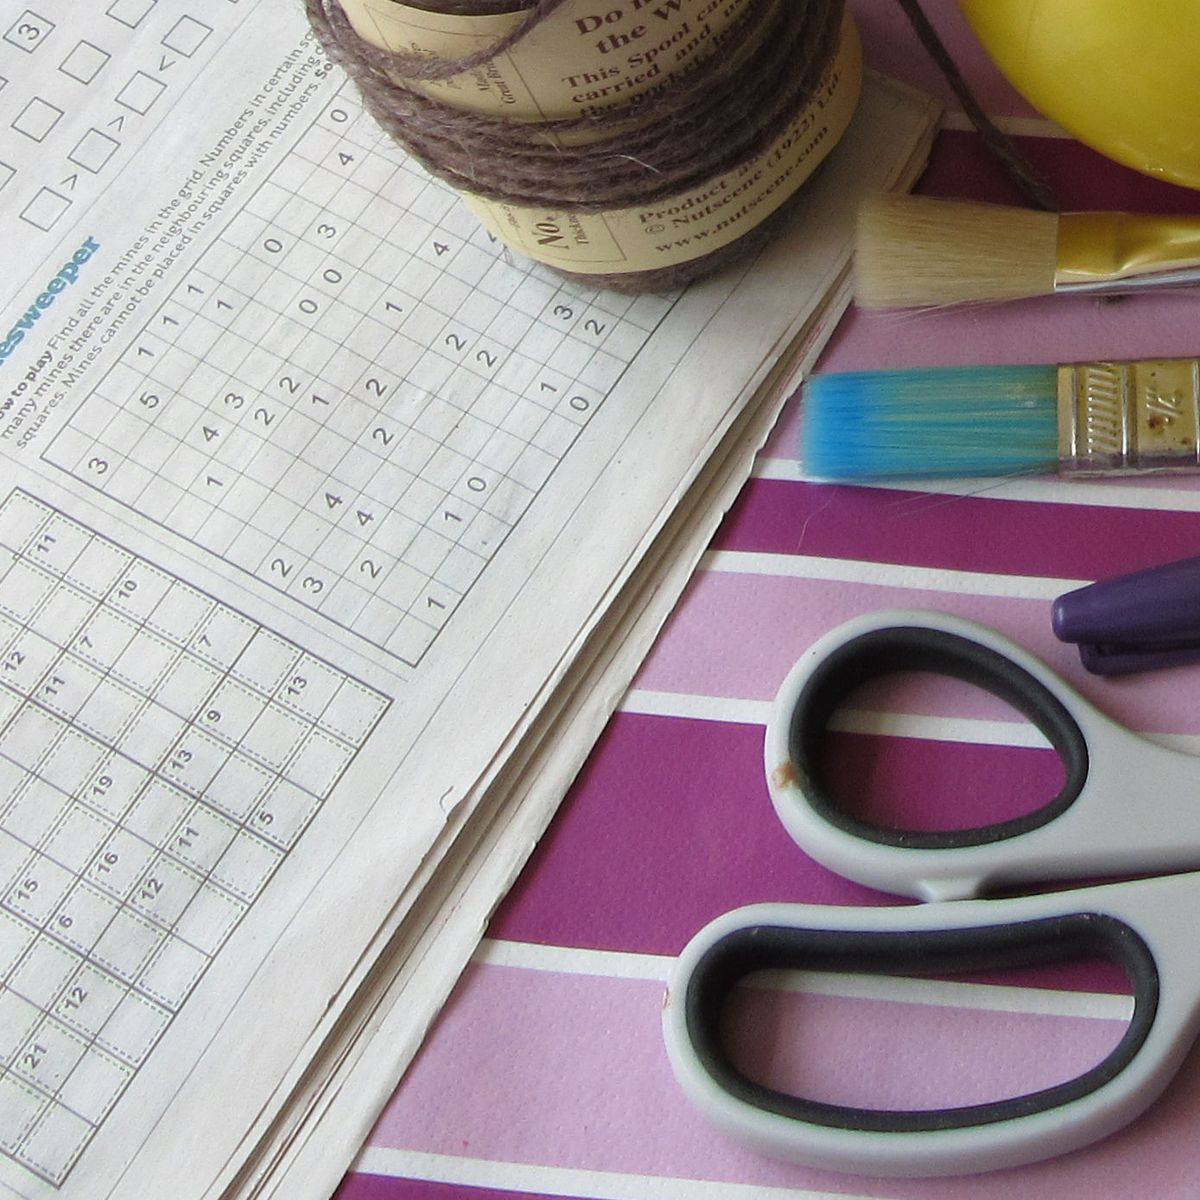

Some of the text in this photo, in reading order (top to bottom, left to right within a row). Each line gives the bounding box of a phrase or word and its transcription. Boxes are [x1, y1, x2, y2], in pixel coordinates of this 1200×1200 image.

[575, 9, 623, 36] Do
[18, 24, 40, 40] 3
[596, 24, 647, 54] the
[562, 66, 620, 88] This
[627, 22, 690, 68] Spool
[572, 63, 661, 103] carried
[675, 24, 711, 61] and
[330, 109, 348, 122] 0
[339, 153, 354, 166] 4
[656, 127, 828, 252] www.nutscene.com
[639, 180, 728, 223] Product
[671, 171, 762, 229] Nutscene
[10, 381, 29, 398] to
[24, 349, 54, 383] play
[46, 315, 81, 351] Find
[76, 298, 96, 318] all
[90, 276, 115, 298] the
[110, 235, 150, 276] mines
[143, 221, 164, 234] in
[157, 198, 182, 220] the
[198, 108, 255, 168] Numbers
[248, 93, 267, 108] in
[262, 48, 304, 94] certain
[318, 224, 336, 238] 3
[0, 397, 38, 440] many
[33, 353, 74, 398] mines
[68, 315, 104, 353] there
[100, 291, 123, 316] are
[116, 276, 137, 291] in
[130, 253, 155, 276] the
[151, 168, 230, 253] neighbouring
[263, 55, 322, 116] including
[264, 239, 282, 253] 0
[434, 242, 449, 256] 4
[60, 345, 103, 389] Mines
[100, 295, 142, 345] cannot
[134, 278, 156, 296] be
[145, 233, 193, 288] placed
[186, 220, 206, 234] in
[201, 169, 248, 221] squares
[243, 140, 274, 168] with
[323, 269, 342, 283] 0
[188, 285, 204, 293] 1
[0, 236, 100, 366] esweeper
[218, 300, 232, 309] 1
[299, 300, 318, 314] 0
[386, 302, 402, 312] 1
[163, 316, 178, 325] 1
[554, 305, 573, 320] 3
[585, 320, 606, 336] 2
[446, 334, 466, 351] 2
[138, 347, 154, 356] 1
[476, 350, 497, 367] 2
[280, 377, 300, 394] 2
[366, 379, 387, 396] 2
[541, 382, 557, 392] 1
[140, 392, 159, 408] 5
[224, 393, 244, 409] 3
[312, 395, 329, 405] 1
[570, 396, 589, 411] 0
[255, 408, 275, 426] 2
[203, 426, 219, 442] 4
[373, 428, 394, 445] 2
[88, 458, 108, 474] 3
[207, 476, 222, 486] 1
[468, 477, 486, 492] 0
[326, 493, 342, 508] 4
[357, 510, 374, 526] 4
[445, 512, 462, 522] 1
[38, 535, 56, 551] 11
[271, 559, 292, 578] 2
[360, 560, 382, 578] 2
[119, 580, 137, 598] 10
[303, 577, 323, 593] 3
[428, 597, 445, 609] 1
[80, 636, 92, 648] 7
[199, 635, 211, 646] 7
[4, 652, 25, 669] 12
[46, 677, 64, 694] 11
[288, 676, 307, 695] 13
[207, 710, 221, 722] 9
[172, 750, 192, 769] 13
[93, 776, 112, 795] 19
[259, 811, 273, 825] 5
[179, 828, 198, 847] 11
[98, 852, 118, 872] 16
[18, 879, 38, 899] 15
[142, 878, 163, 899] 12
[59, 915, 72, 928] 6
[65, 987, 88, 1008] 12
[24, 1045, 46, 1069] 21
